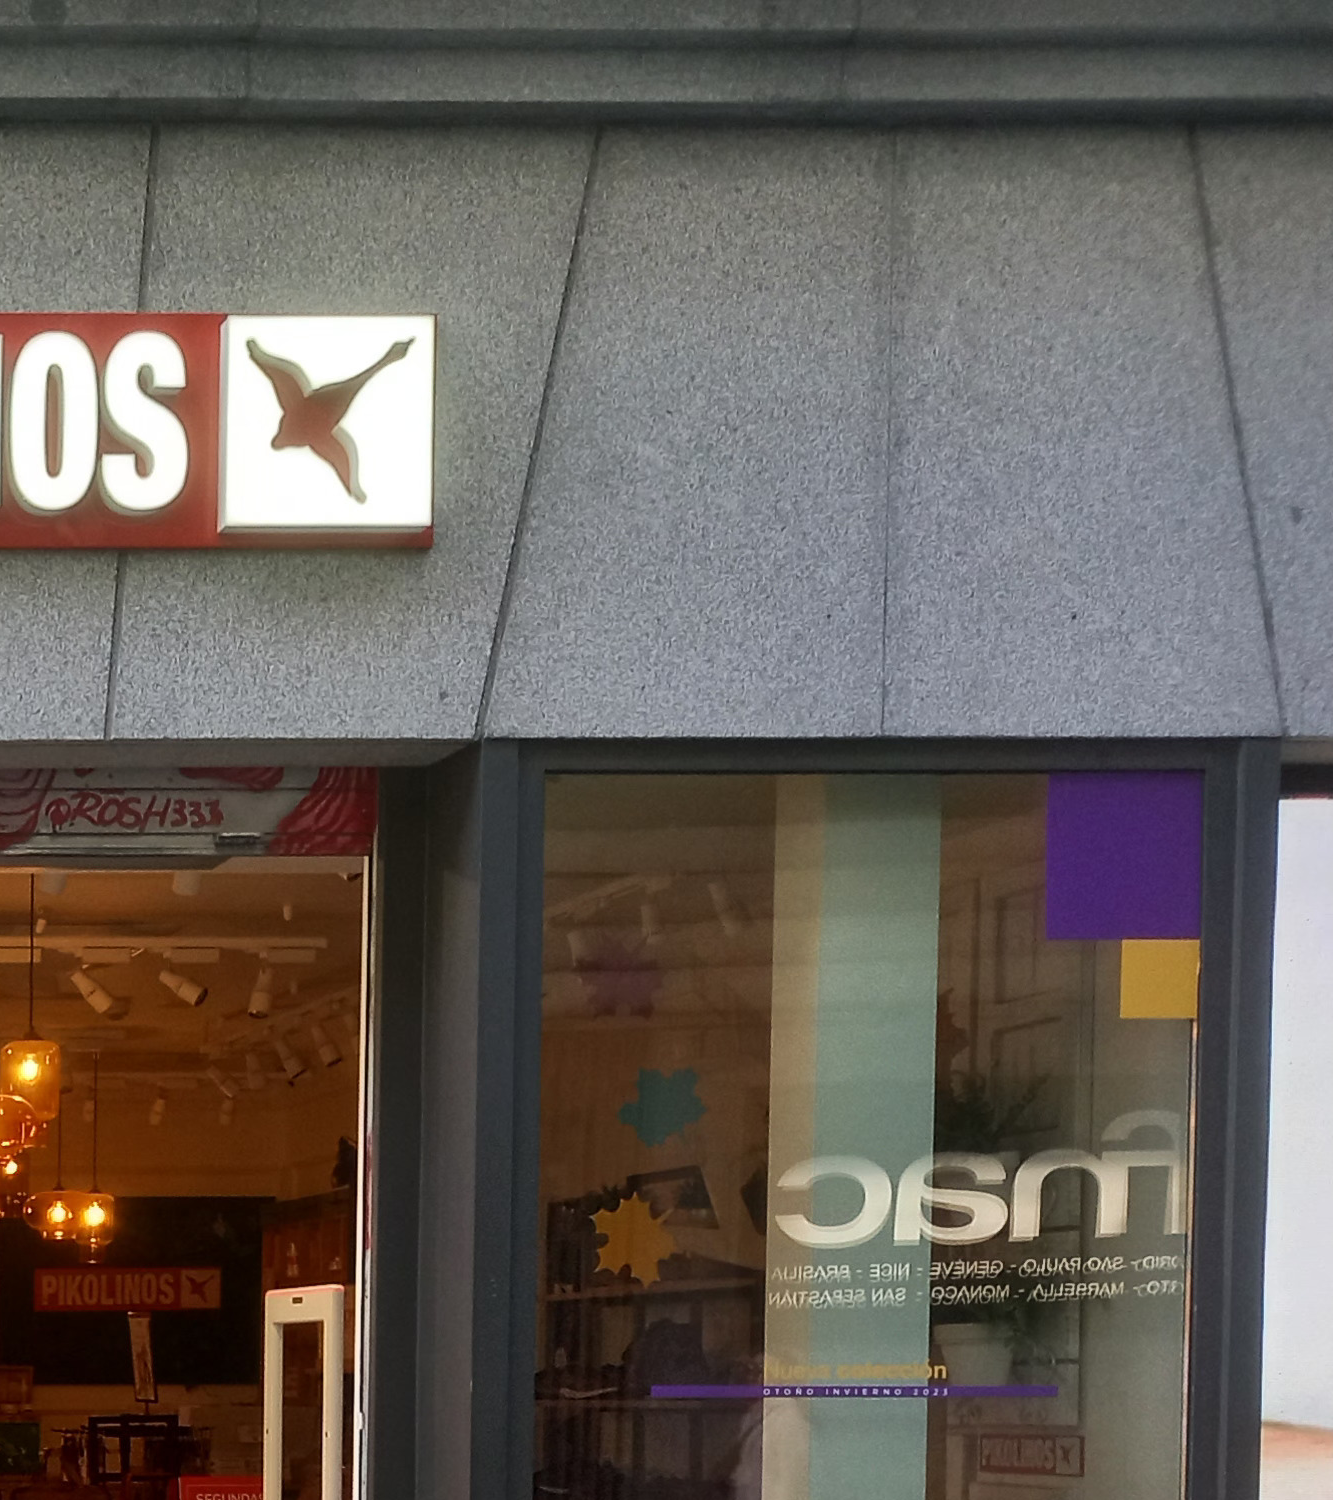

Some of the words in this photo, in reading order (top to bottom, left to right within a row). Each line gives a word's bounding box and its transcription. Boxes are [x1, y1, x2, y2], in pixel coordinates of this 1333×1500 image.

[41, 1274, 175, 1305] PIKOLINOS
[825, 1387, 902, 1396] INVIERNO
[912, 1387, 948, 1396] 2023
